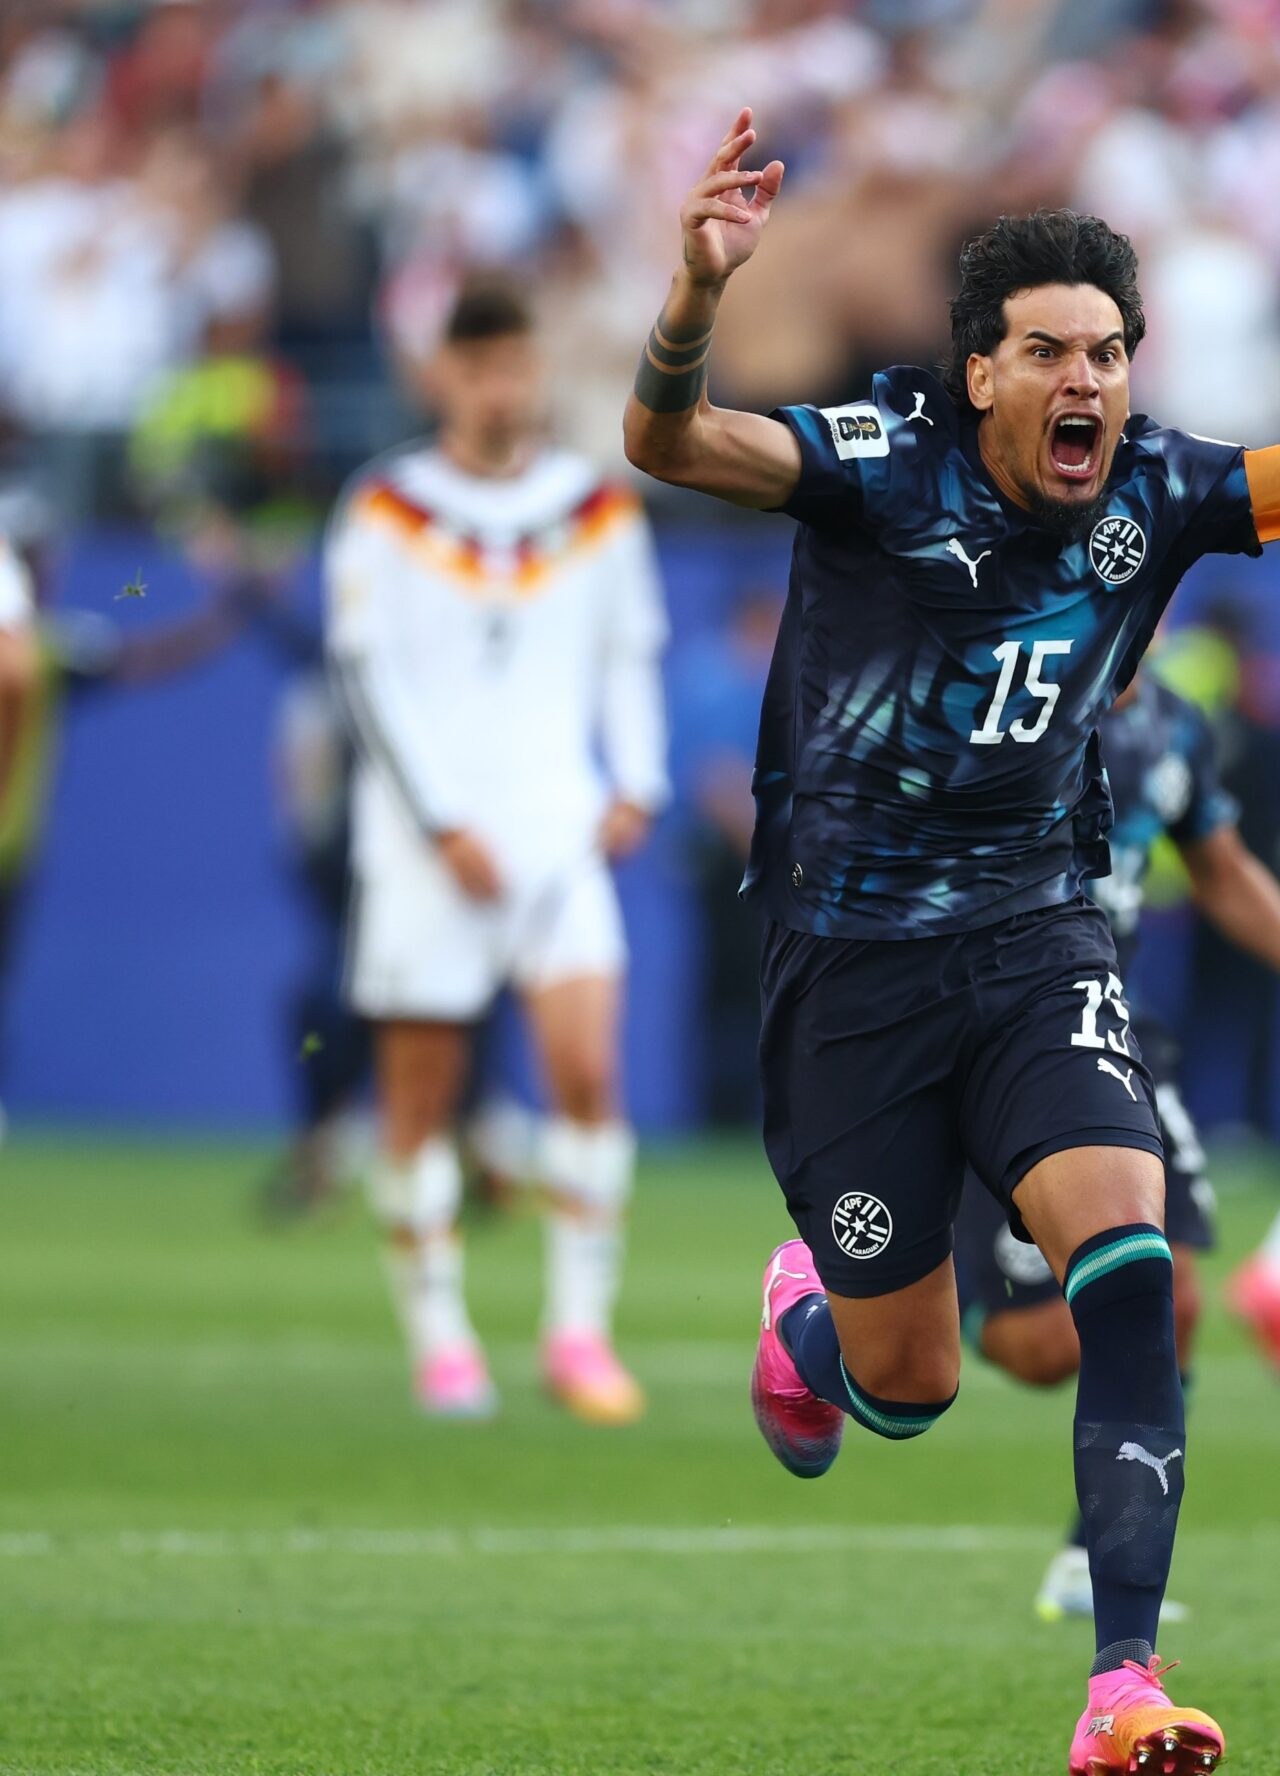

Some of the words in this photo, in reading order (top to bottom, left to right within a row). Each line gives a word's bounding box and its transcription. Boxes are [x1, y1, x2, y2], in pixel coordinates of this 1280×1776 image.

[1103, 520, 1121, 536] APF
[969, 639, 1075, 744] 15
[1071, 971, 1130, 1057] 15
[844, 1196, 862, 1211] APF
[851, 1242, 880, 1255] PARAGUAY
